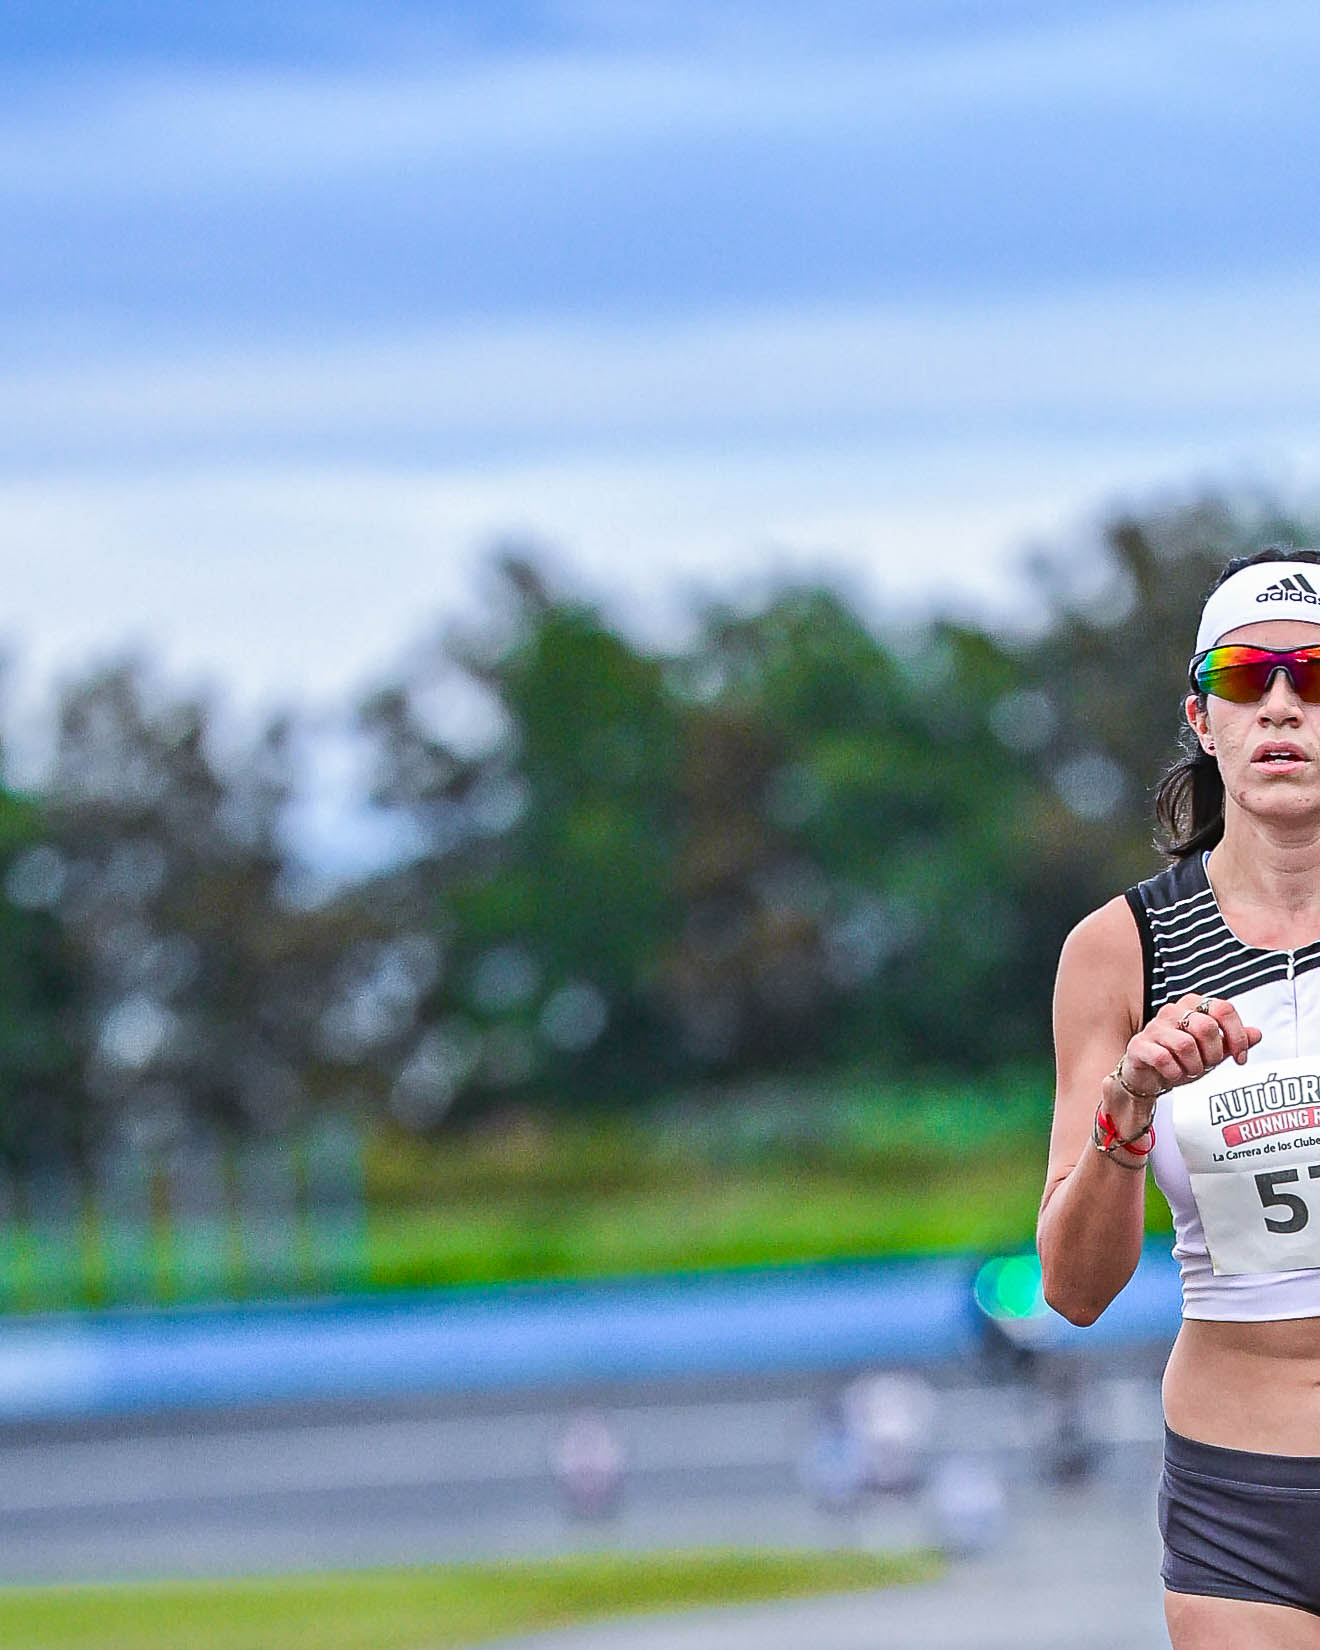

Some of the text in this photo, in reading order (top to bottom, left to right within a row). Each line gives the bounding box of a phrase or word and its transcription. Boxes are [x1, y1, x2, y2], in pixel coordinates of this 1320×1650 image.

[1238, 1110, 1309, 1142] RUNNING
[1213, 1152, 1225, 1163] La
[1226, 1147, 1262, 1161] Carrera
[1264, 1143, 1276, 1154] de
[1278, 1140, 1292, 1151] los
